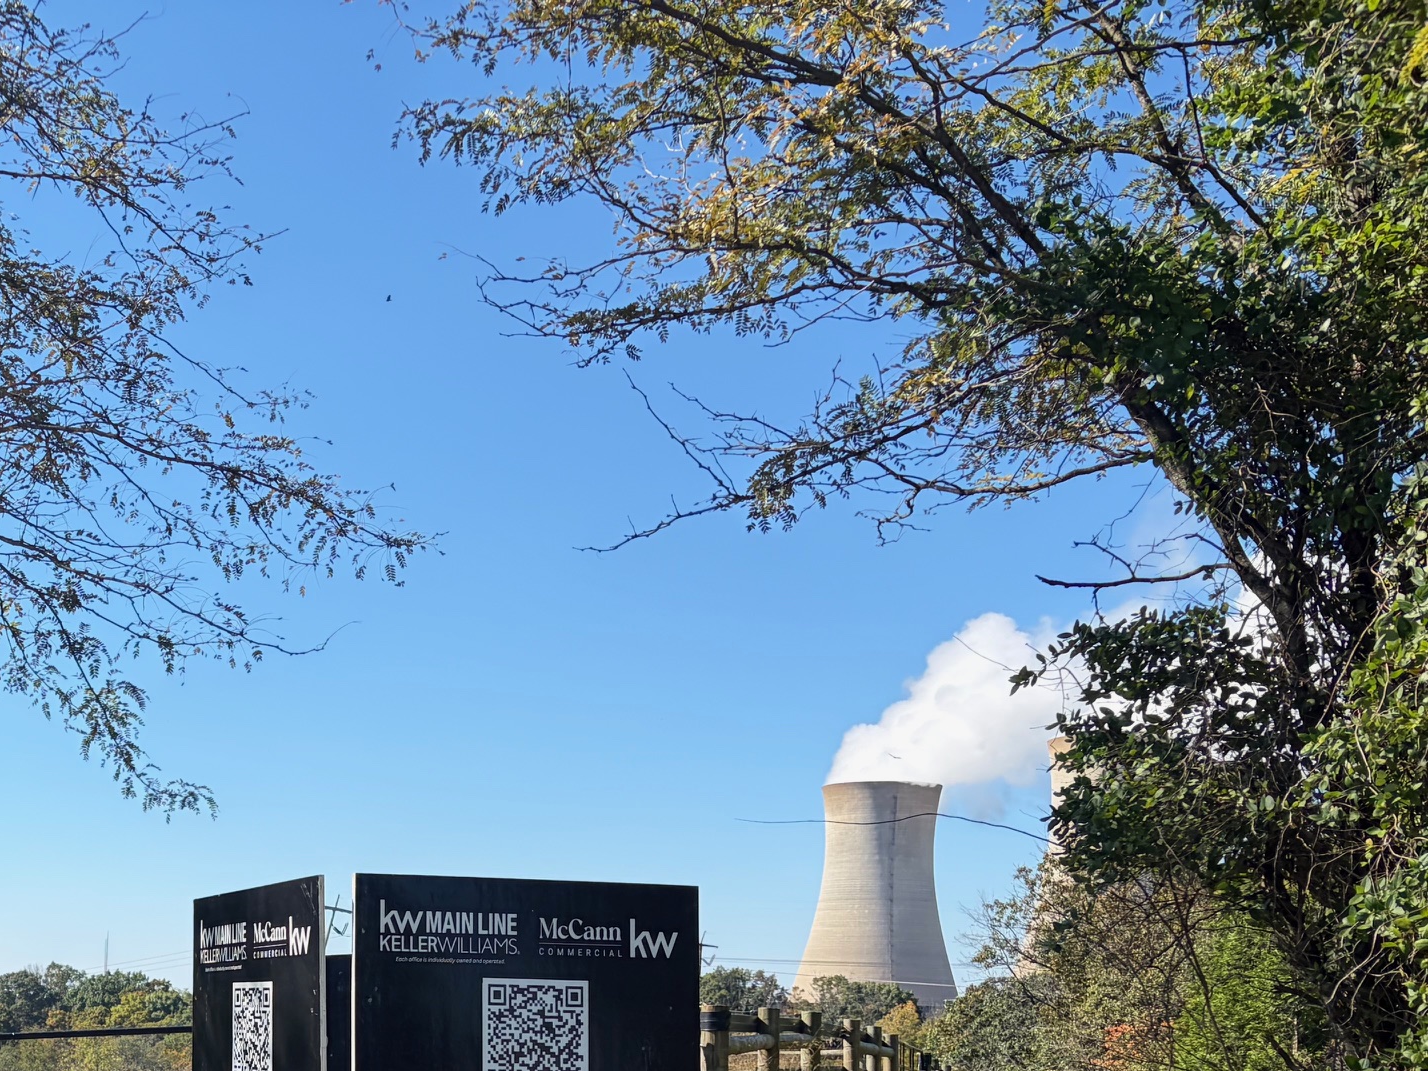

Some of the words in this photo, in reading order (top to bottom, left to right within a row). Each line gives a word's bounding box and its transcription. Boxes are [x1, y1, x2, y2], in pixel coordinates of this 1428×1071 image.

[200, 919, 215, 949] kw
[214, 923, 232, 946] MAIN
[232, 921, 247, 944] LINE
[379, 899, 424, 934] kw
[425, 910, 474, 935] MAIN
[477, 912, 518, 936] LINE
[253, 921, 287, 943] McCann
[289, 915, 311, 956] kw
[538, 917, 622, 941] McCann
[629, 918, 679, 959] kw
[253, 948, 287, 960] COMMERCIAL
[538, 947, 623, 958] COMMERCIAL
